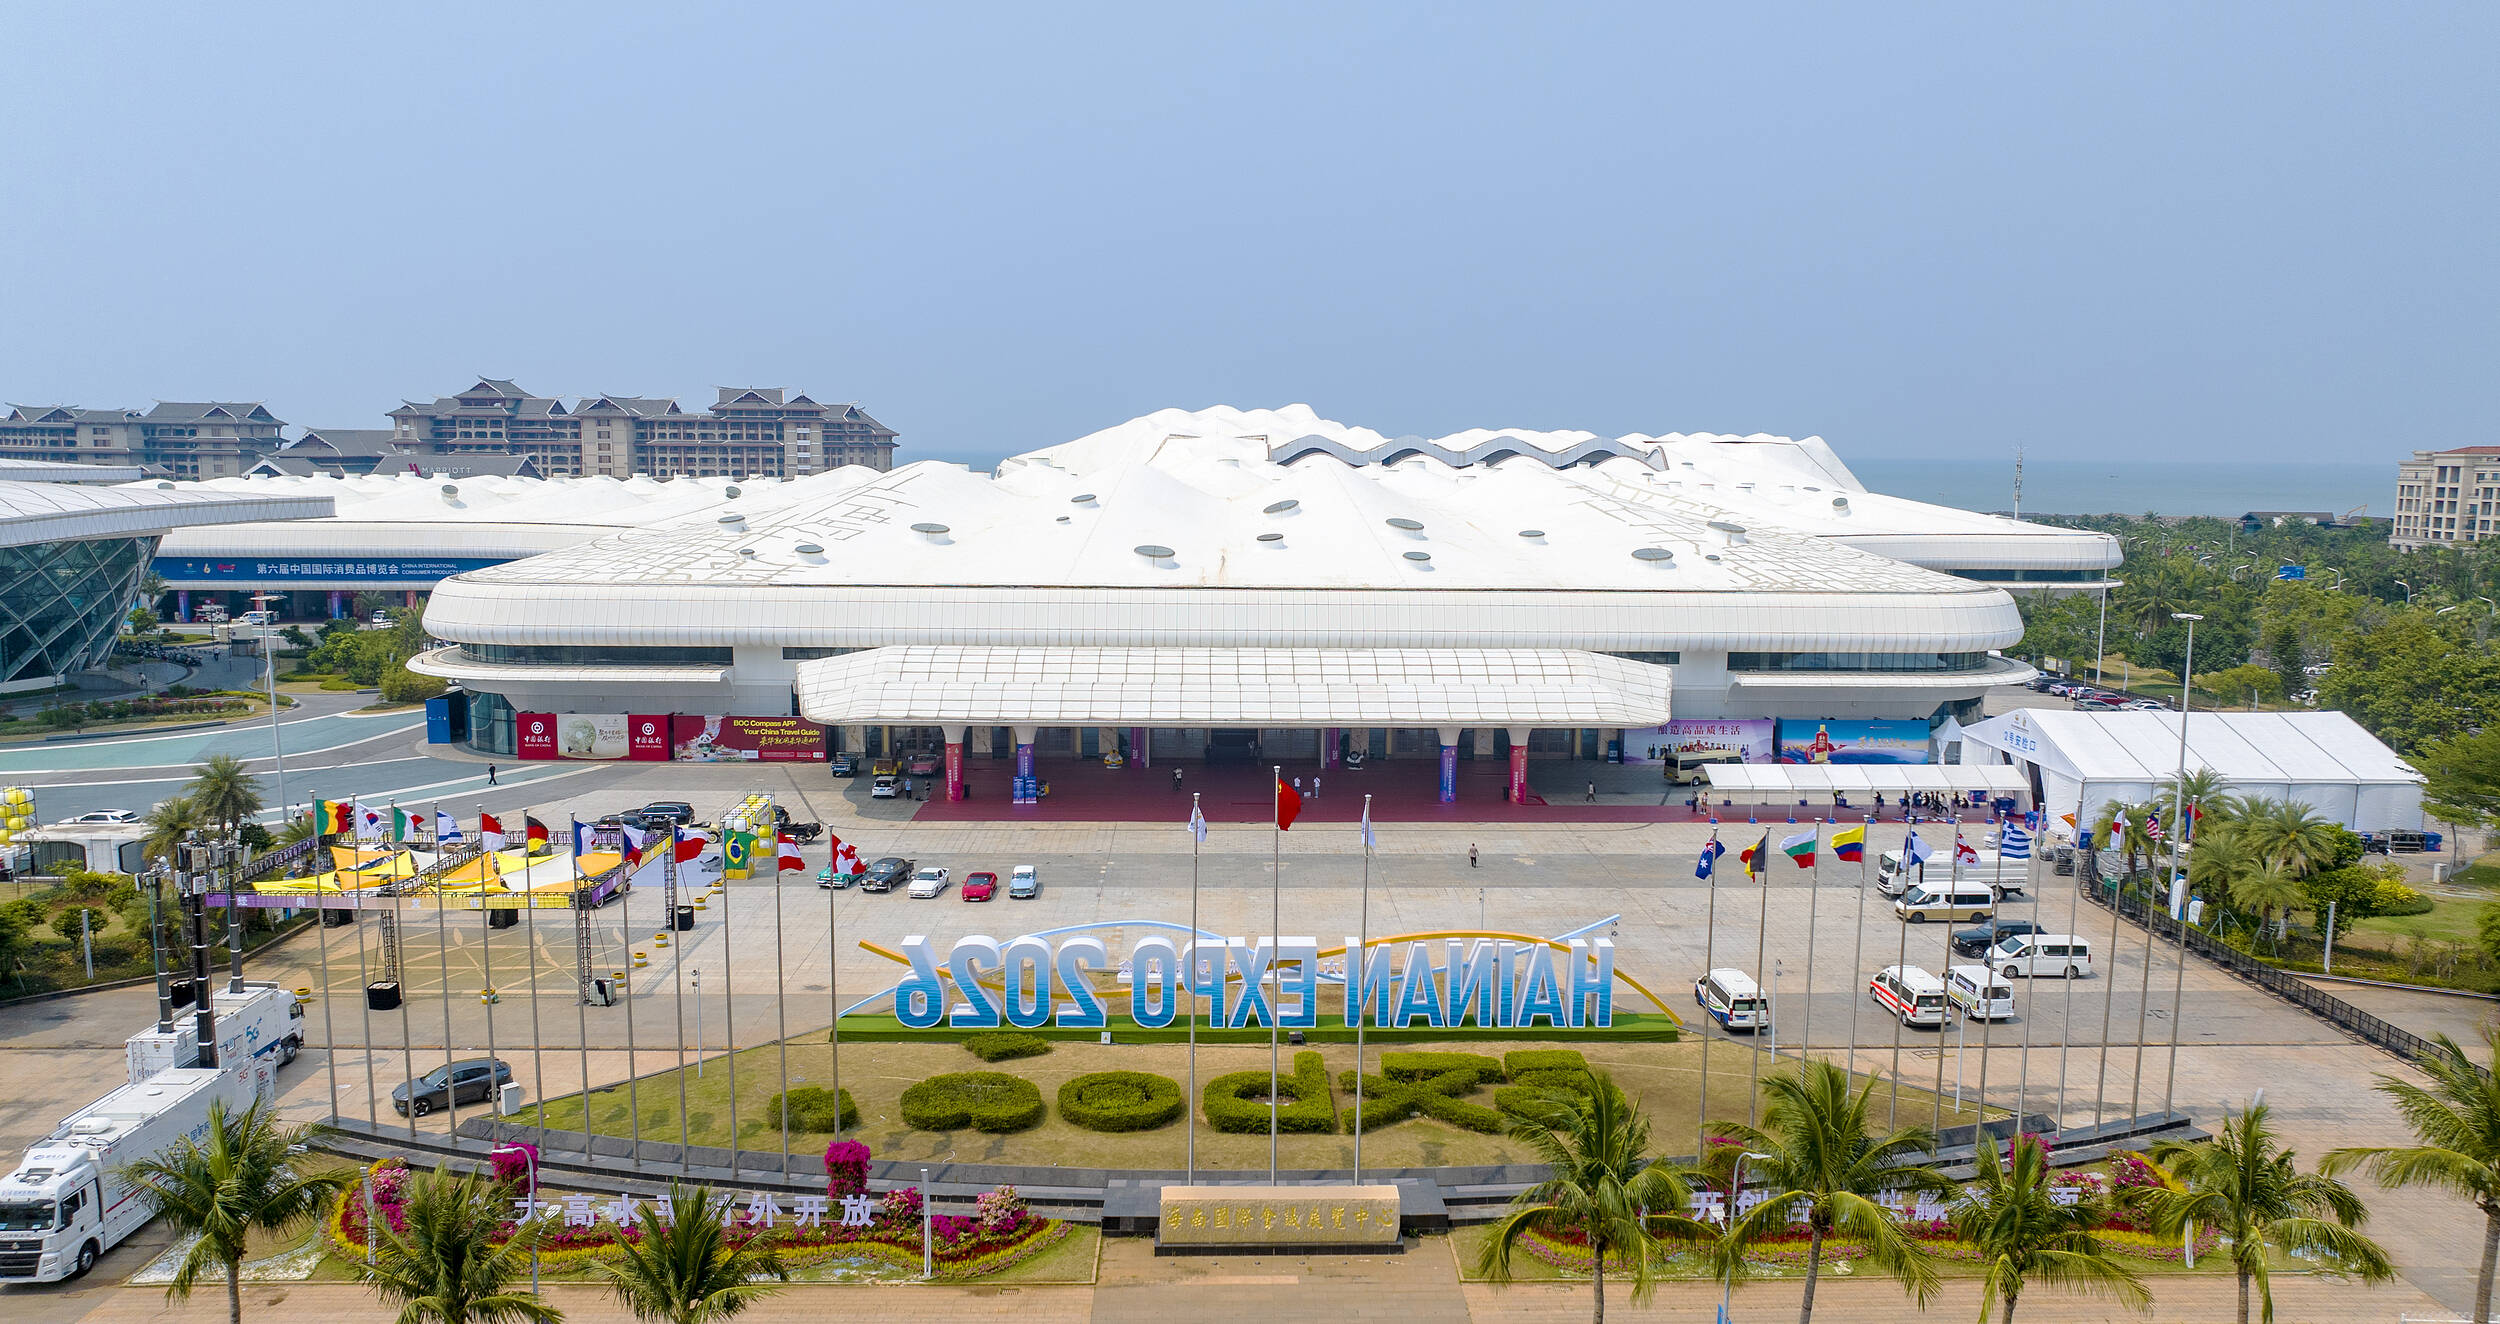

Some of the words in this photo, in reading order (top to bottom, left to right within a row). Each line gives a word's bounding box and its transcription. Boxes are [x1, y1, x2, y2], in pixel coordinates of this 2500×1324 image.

[422, 466, 472, 474] MARRIOTT
[257, 563, 399, 575] 第六届中国国际消费品博览会
[733, 719, 749, 727] BOC
[750, 719, 781, 728] Compass
[782, 719, 797, 727] APP
[744, 728, 759, 736] Your
[760, 728, 779, 736] China
[780, 728, 800, 736] Travel
[800, 728, 820, 736] Guide
[1657, 725, 1741, 736] 酿造高品质生活
[2004, 731, 2036, 752] 2号安检口
[245, 1025, 260, 1043] 5G
[238, 1068, 249, 1083] 5G
